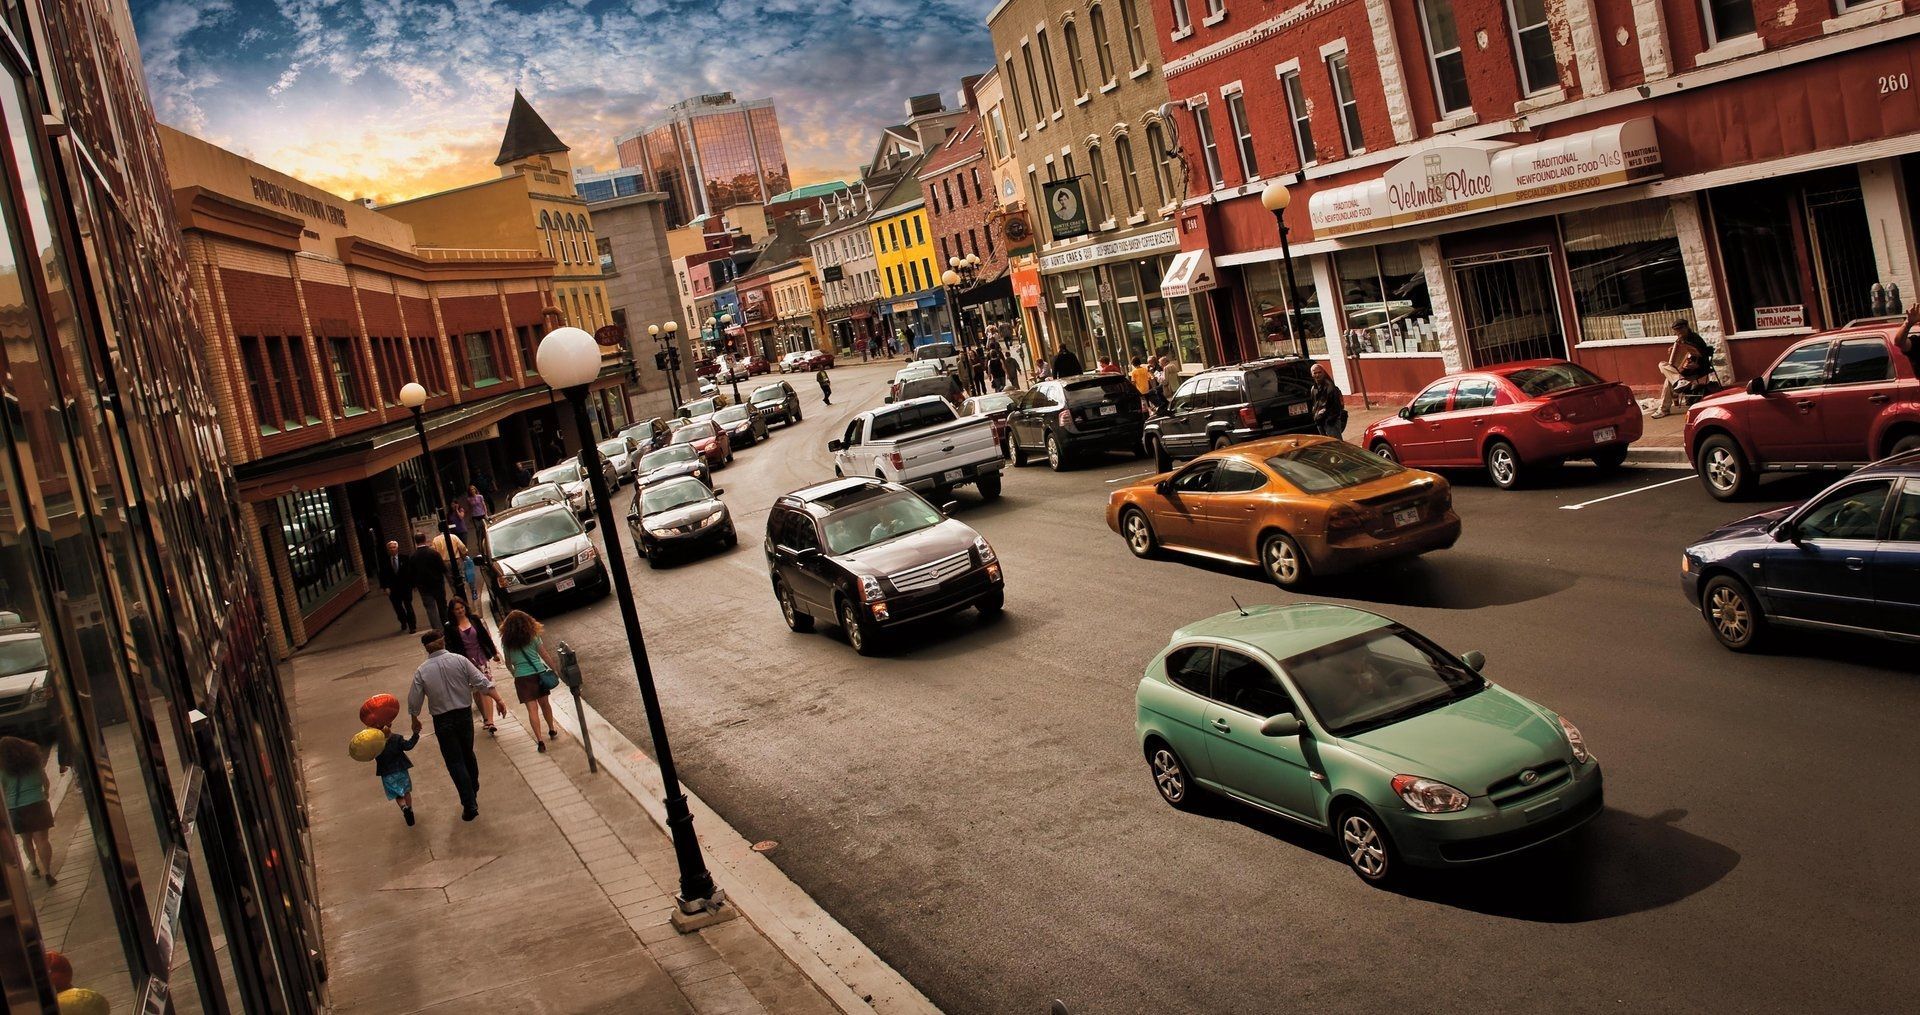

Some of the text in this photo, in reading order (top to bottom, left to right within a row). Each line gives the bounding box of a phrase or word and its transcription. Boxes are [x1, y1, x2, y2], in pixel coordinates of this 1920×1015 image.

[1878, 72, 1909, 94] 260
[1624, 146, 1659, 159] TRADITIONAL
[1643, 155, 1658, 164] FOOD
[1532, 152, 1578, 170] TRADITIONAL
[1516, 160, 1599, 186] NEWFOUNDLAND FOOD
[1445, 168, 1492, 200] Place
[1515, 177, 1600, 200] SPECIALIZING IN SEAFOOD
[1333, 200, 1360, 211] TRADITIONAL
[1446, 202, 1470, 214] STREET
[1324, 207, 1372, 223] NEWFOUNDLAND FOOD
[1757, 316, 1791, 327] ENTRANCE
